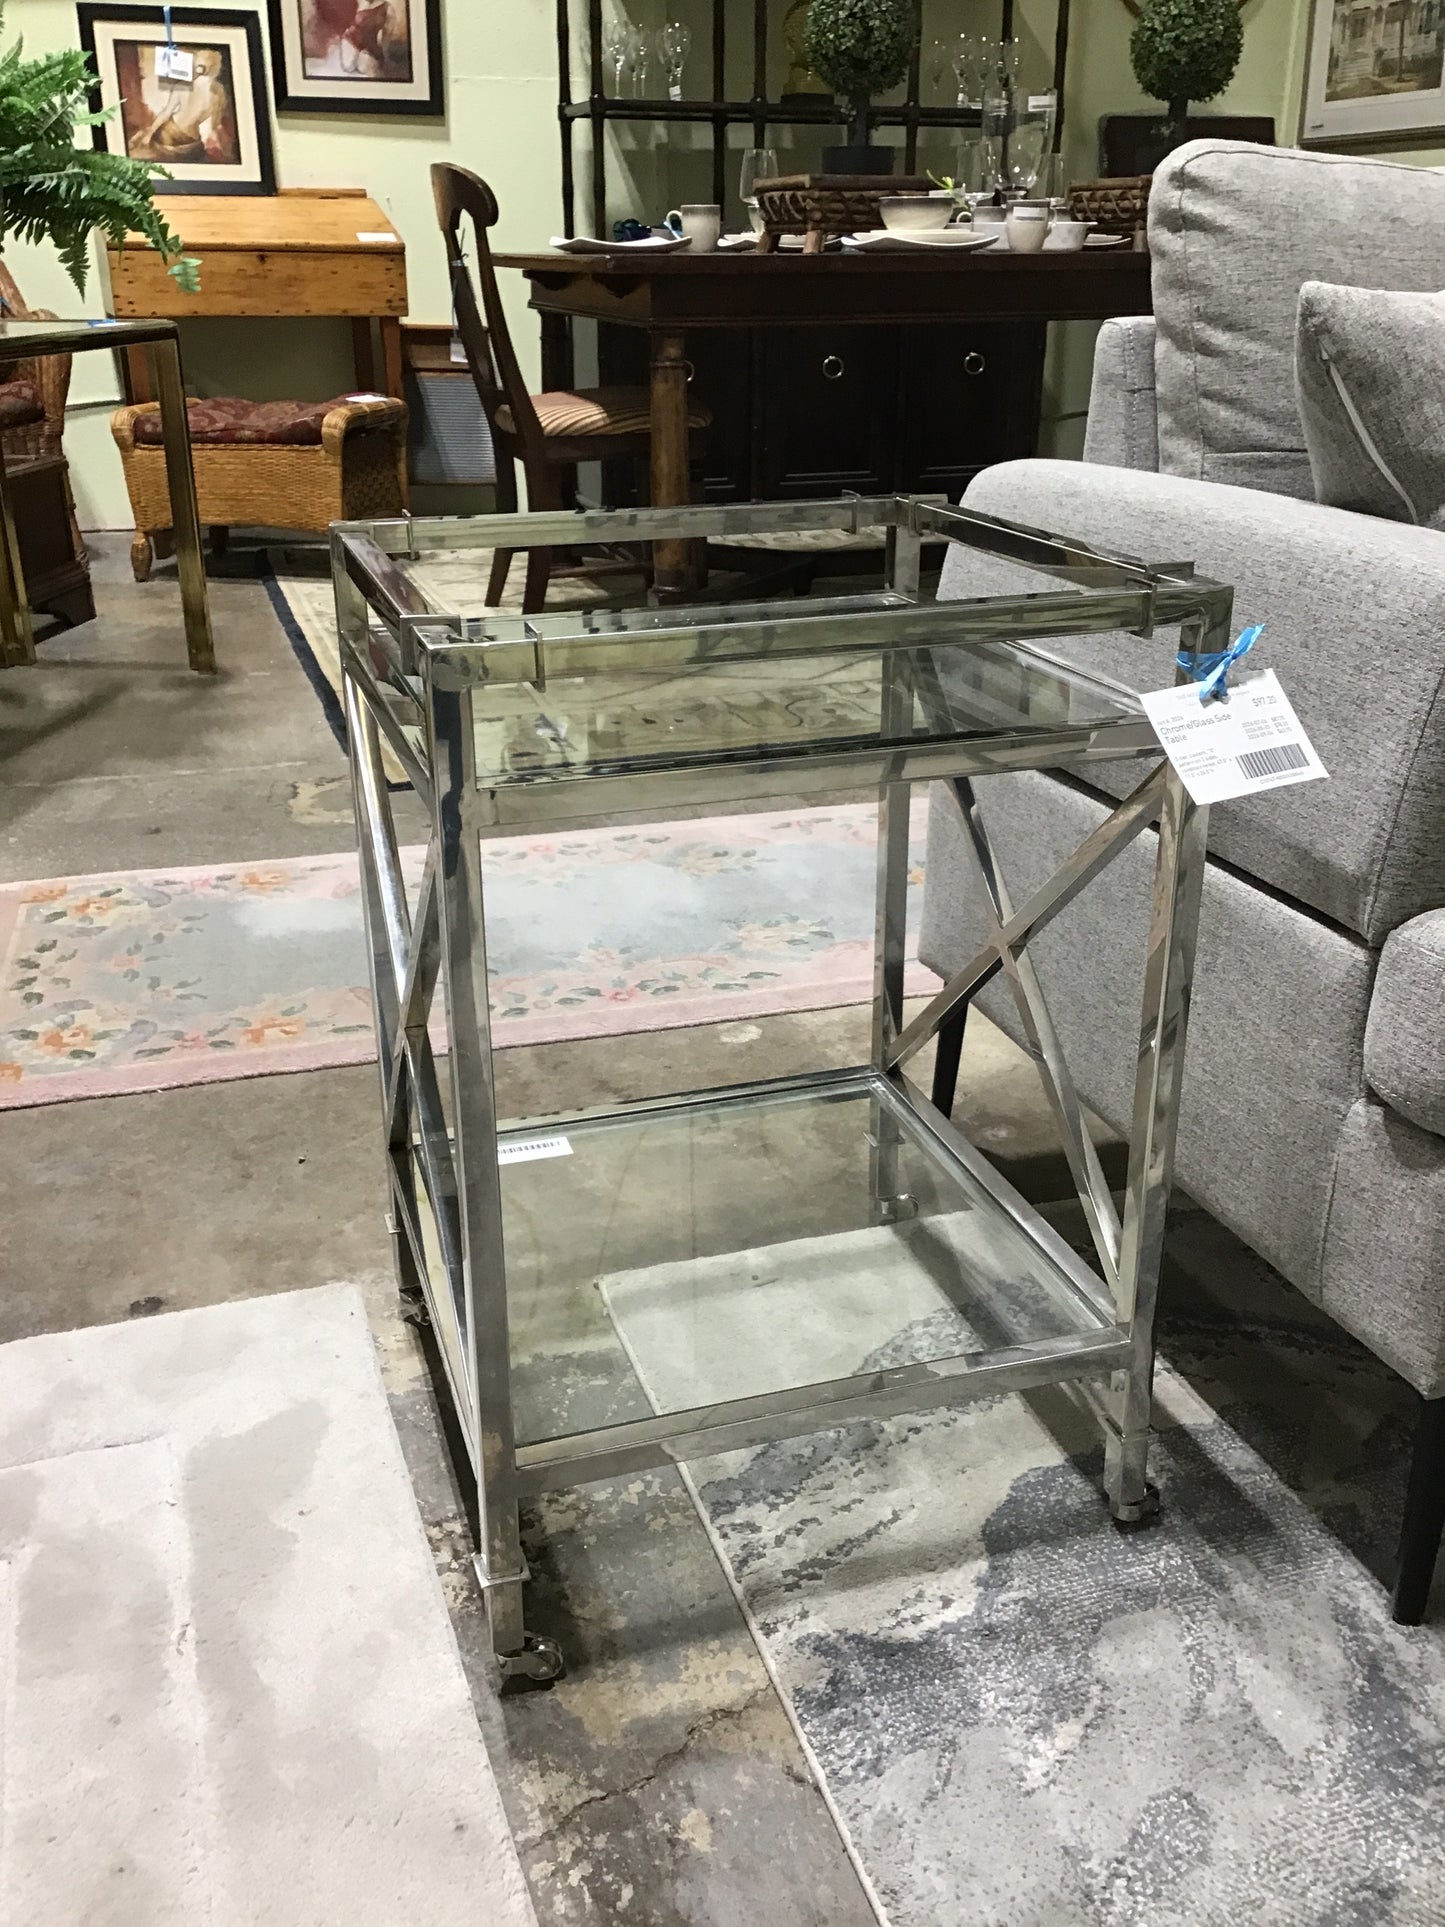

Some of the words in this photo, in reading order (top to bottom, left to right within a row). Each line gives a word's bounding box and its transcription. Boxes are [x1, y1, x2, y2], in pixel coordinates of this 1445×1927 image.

[1160, 717, 1215, 735] Chrome/Glass
[1214, 713, 1232, 723] Side
[1164, 733, 1188, 744] Table
